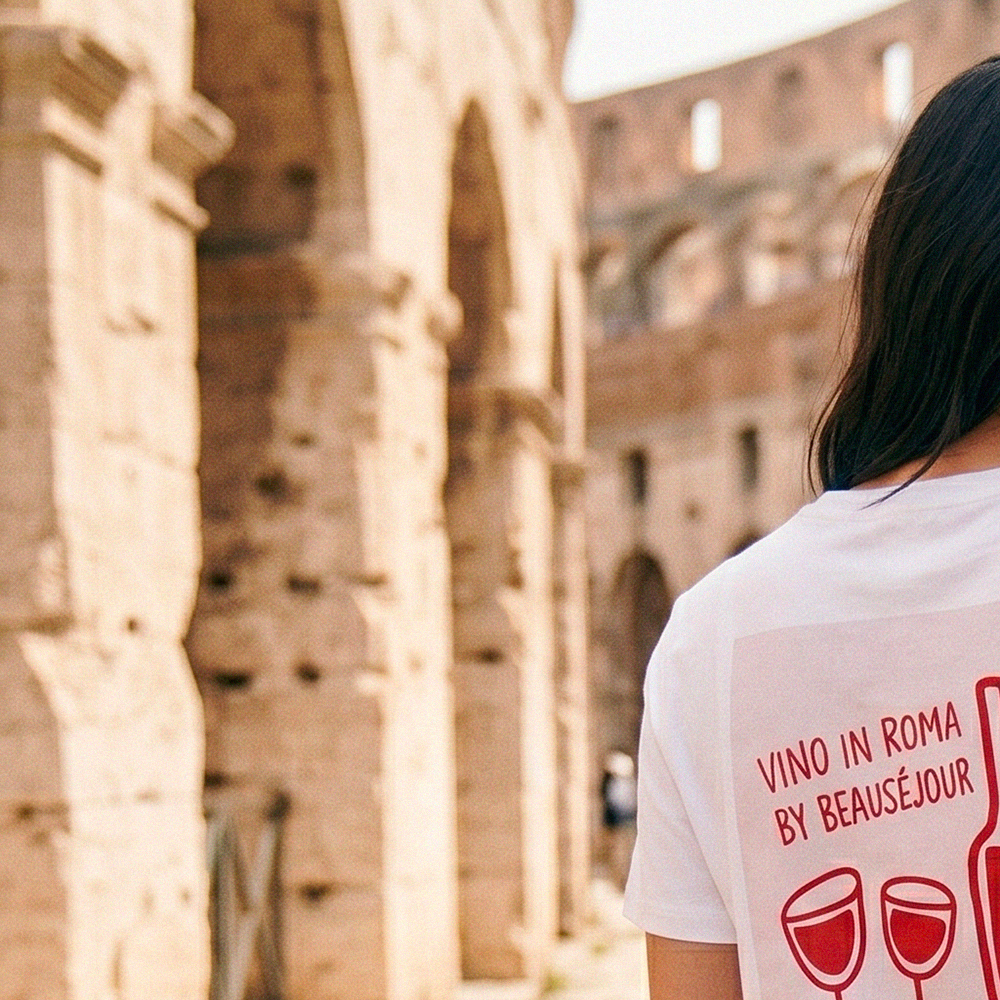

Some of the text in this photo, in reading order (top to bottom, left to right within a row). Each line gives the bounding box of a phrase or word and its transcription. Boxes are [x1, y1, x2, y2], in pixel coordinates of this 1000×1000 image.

[757, 701, 962, 793] VINO IN ROMA
[774, 757, 974, 846] BY BEAUSÉJOUR
